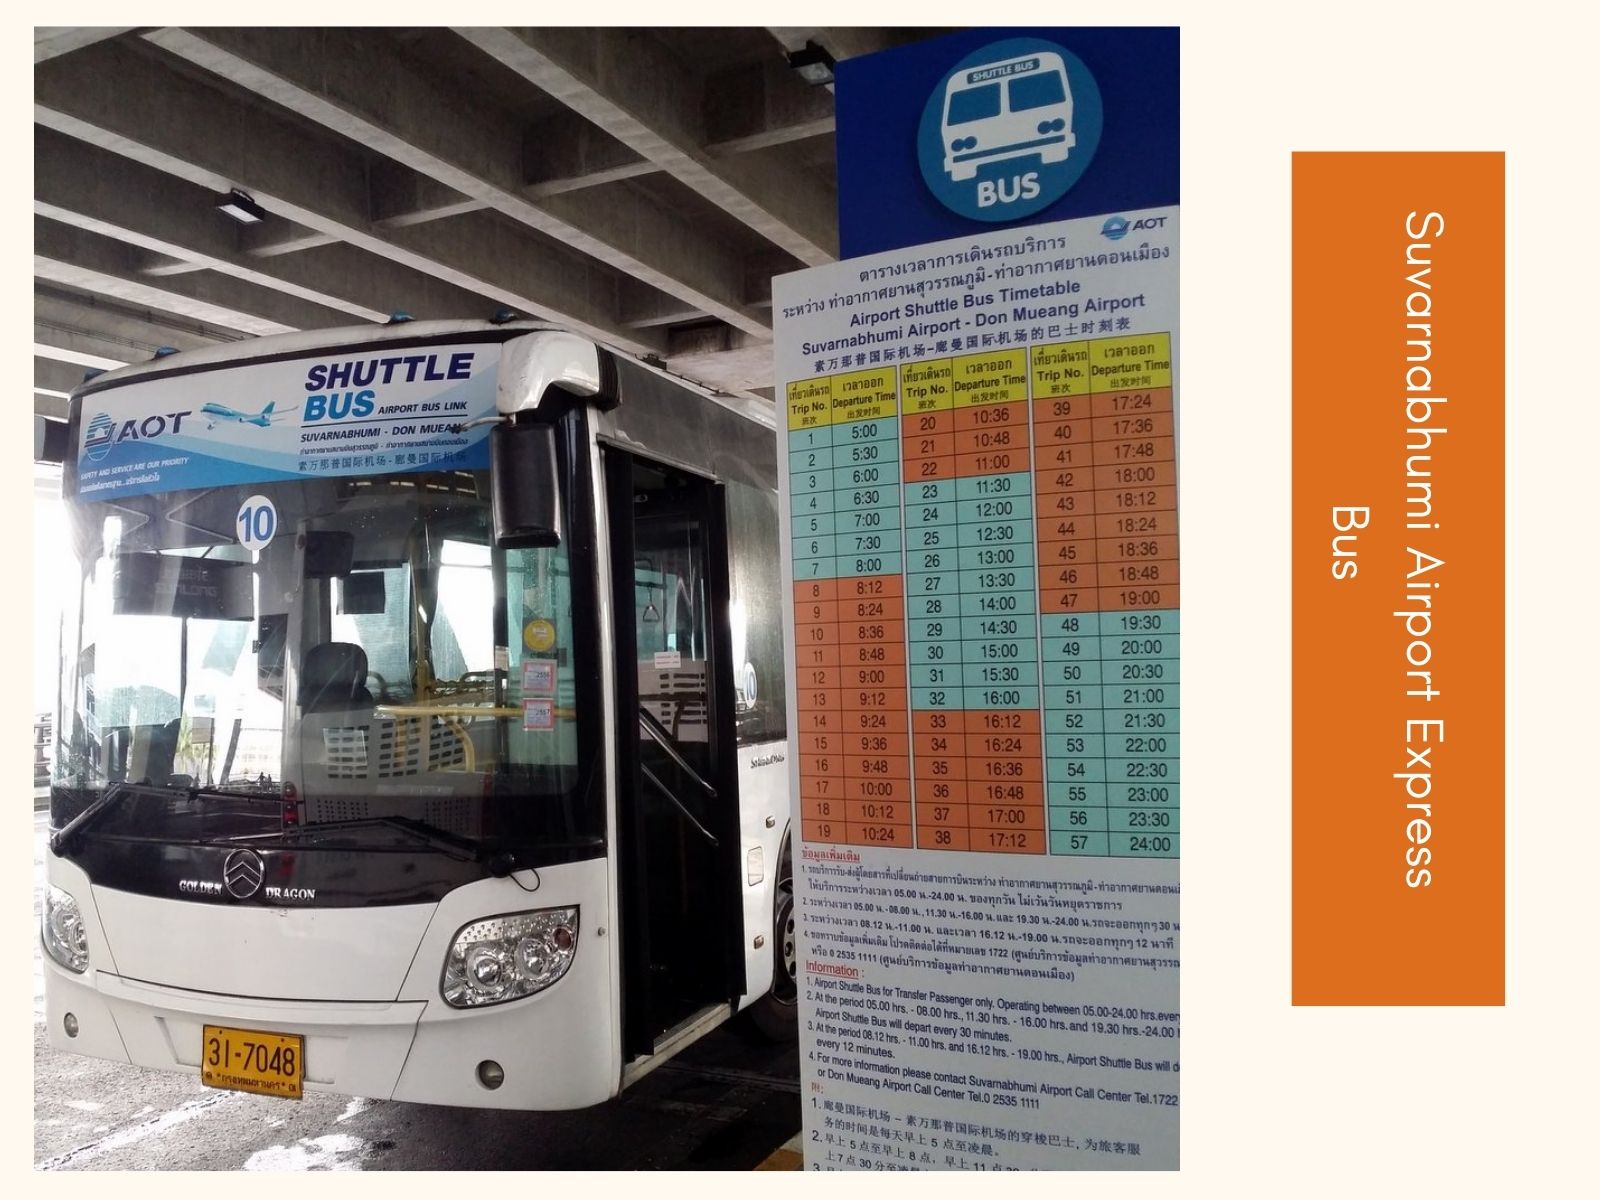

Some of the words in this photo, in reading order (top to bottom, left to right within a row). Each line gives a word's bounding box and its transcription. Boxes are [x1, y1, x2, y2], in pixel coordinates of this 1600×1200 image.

[973, 65, 1012, 82] SHUTTLE
[1014, 61, 1034, 73] BUS
[977, 172, 1041, 208] BUS
[1132, 217, 1168, 231] AOT
[859, 236, 1066, 282] ตารางเวลาการเดินรถบริการ
[783, 298, 825, 319] ระหว่าง
[850, 308, 900, 327] Airport
[905, 298, 958, 317] Shuttle
[964, 294, 994, 308] Bus
[1000, 281, 1081, 302] Timetable
[802, 328, 902, 355] Suvarnabhumi
[907, 318, 961, 337] Airport
[976, 312, 1007, 327] Don
[1013, 303, 1079, 321] Mueang
[1084, 293, 1146, 313] Airport
[1033, 349, 1087, 366] เที่ยวเดินรถ
[1104, 344, 1155, 358] เวลาออก
[305, 353, 475, 392] SHUTTLE
[903, 366, 951, 384] เที่ยวเดินรถ
[966, 359, 1012, 375] เวลาออก
[1037, 371, 1064, 383] Trip
[1066, 367, 1084, 379] No.
[1091, 363, 1141, 377] Departure
[1144, 359, 1170, 371] Time
[842, 376, 884, 393] เวลาออก
[907, 387, 930, 399] Trip
[932, 383, 948, 394] No.
[954, 379, 1000, 393] Departure
[1002, 375, 1026, 385] Time
[1110, 376, 1151, 388] 出发时间
[789, 382, 830, 402] เที่ยวเดินรถ
[833, 395, 873, 409] Departure
[875, 391, 897, 402] Time
[971, 390, 1009, 403] 出发时间
[303, 389, 376, 422] BUS
[378, 403, 420, 415] AIRPORT
[421, 402, 441, 412] BUS
[444, 401, 468, 411] LINK
[792, 405, 810, 415] Trip
[812, 402, 828, 413] No.
[847, 407, 881, 419] 出发时间
[1054, 401, 1070, 416] 39
[1112, 394, 1152, 410] 17:24
[117, 410, 192, 442] AOT
[920, 416, 936, 430] 20
[973, 408, 1009, 424] 10:36
[300, 427, 381, 443] SUVARNABHUMI
[392, 425, 416, 436] DON
[808, 432, 813, 444] 1
[852, 424, 877, 439] 5:00
[1056, 449, 1072, 463] 41
[1114, 442, 1154, 458] 17:48
[111, 465, 133, 475] SERVICE
[134, 463, 146, 471] ARE
[147, 460, 160, 469] OUR
[161, 457, 190, 467] PRIORITY
[922, 462, 937, 476] 22
[976, 455, 1010, 470] 11:00
[809, 475, 816, 488] 3
[853, 468, 878, 483] 6:00
[1056, 496, 1074, 510] 43
[1116, 491, 1156, 507] 18:12
[923, 508, 938, 521] 24
[976, 501, 1012, 516] 12:00
[239, 505, 275, 541] 10
[810, 518, 817, 531] 5
[855, 512, 880, 527] 7:00
[925, 554, 940, 568] 26
[978, 549, 1014, 564] 13:00
[1059, 546, 1076, 560] 45
[1118, 541, 1158, 556] 18:36
[812, 563, 819, 575] 7
[856, 558, 881, 572] 8:00
[926, 600, 942, 613] 28
[980, 596, 1016, 611] 14:00
[1060, 594, 1078, 607] 47
[1120, 590, 1160, 605] 19:00
[814, 606, 820, 619] 9
[858, 602, 883, 616] 8:24
[813, 650, 822, 662] 11
[860, 648, 885, 661] 8:48
[928, 646, 943, 659] 30
[981, 644, 1018, 658] 15:00
[1062, 642, 1080, 656] 49
[1122, 640, 1162, 654] 20:00
[813, 693, 826, 706] 13
[860, 692, 885, 705] 9:12
[930, 692, 945, 705] 32
[983, 691, 1020, 704] 16:00
[1066, 690, 1081, 704] 51
[1124, 688, 1164, 703] 21:00
[814, 737, 827, 750] 15
[862, 737, 887, 750] 9:36
[932, 738, 947, 751] 34
[985, 738, 1022, 752] 16:24
[1067, 738, 1084, 752] 53
[1126, 738, 1166, 752] 22:00
[818, 824, 831, 837] 19
[862, 827, 895, 841] 10:24
[936, 830, 951, 844] 38
[989, 833, 1026, 848] 17:12
[1071, 835, 1088, 849] 57
[1130, 836, 1170, 852] 24:00
[179, 879, 222, 895] GOLDEN
[265, 887, 316, 900] DRAGON
[805, 959, 859, 977] Information
[814, 977, 837, 990] Airport
[839, 981, 864, 993] Shuttle
[866, 985, 881, 996] Bus
[882, 987, 893, 997] for
[895, 987, 927, 1000] Transfer
[929, 991, 974, 1007] Passenger
[975, 997, 995, 1010] only.
[997, 998, 1040, 1014] Operating
[1042, 1002, 1081, 1015] between
[1083, 1005, 1138, 1019] 05.00-24.00
[208, 1037, 295, 1077] 31-7048
[818, 1069, 826, 1078] or
[828, 1069, 844, 1081] Don
[846, 1073, 881, 1089] Mueang
[882, 1078, 912, 1093] Airport
[914, 1082, 931, 1094] Call
[934, 1085, 965, 1100] Center
[968, 1090, 990, 1104] Tel.0
[993, 1094, 1018, 1107] 2535
[1021, 1097, 1040, 1109] 1111
